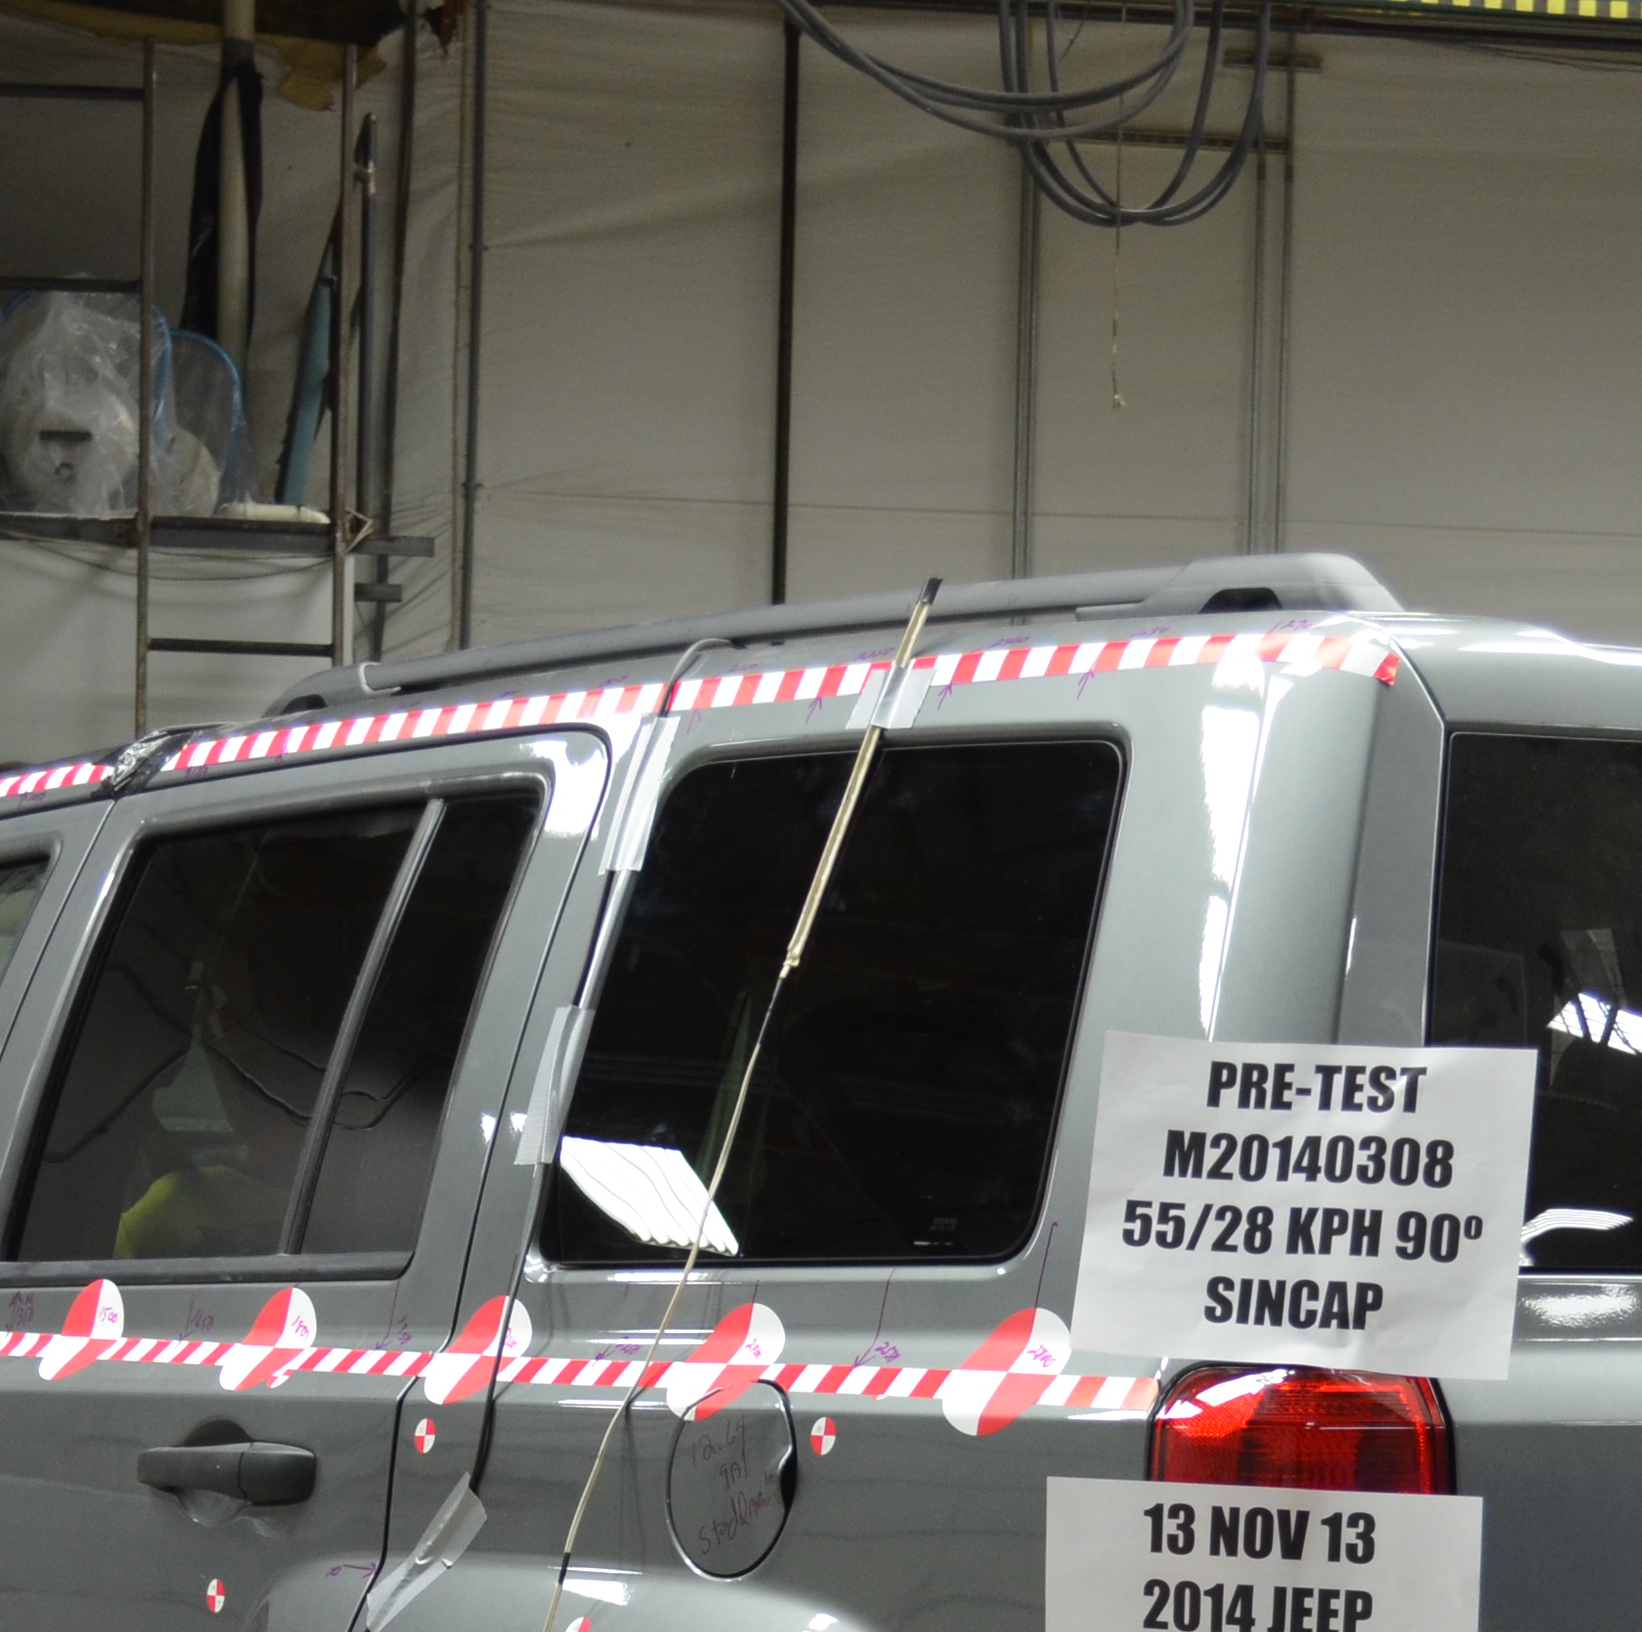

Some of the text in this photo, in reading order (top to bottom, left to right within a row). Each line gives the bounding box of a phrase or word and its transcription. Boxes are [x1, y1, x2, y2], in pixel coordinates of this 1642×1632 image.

[1206, 1060, 1427, 1113] PRE-TEST
[1162, 1129, 1454, 1188] M20140308
[1122, 1199, 1274, 1254] 55/28
[1285, 1207, 1383, 1257] KPH
[1203, 1275, 1383, 1330] SINCAP
[1142, 1502, 1377, 1565] 13 NOV 13
